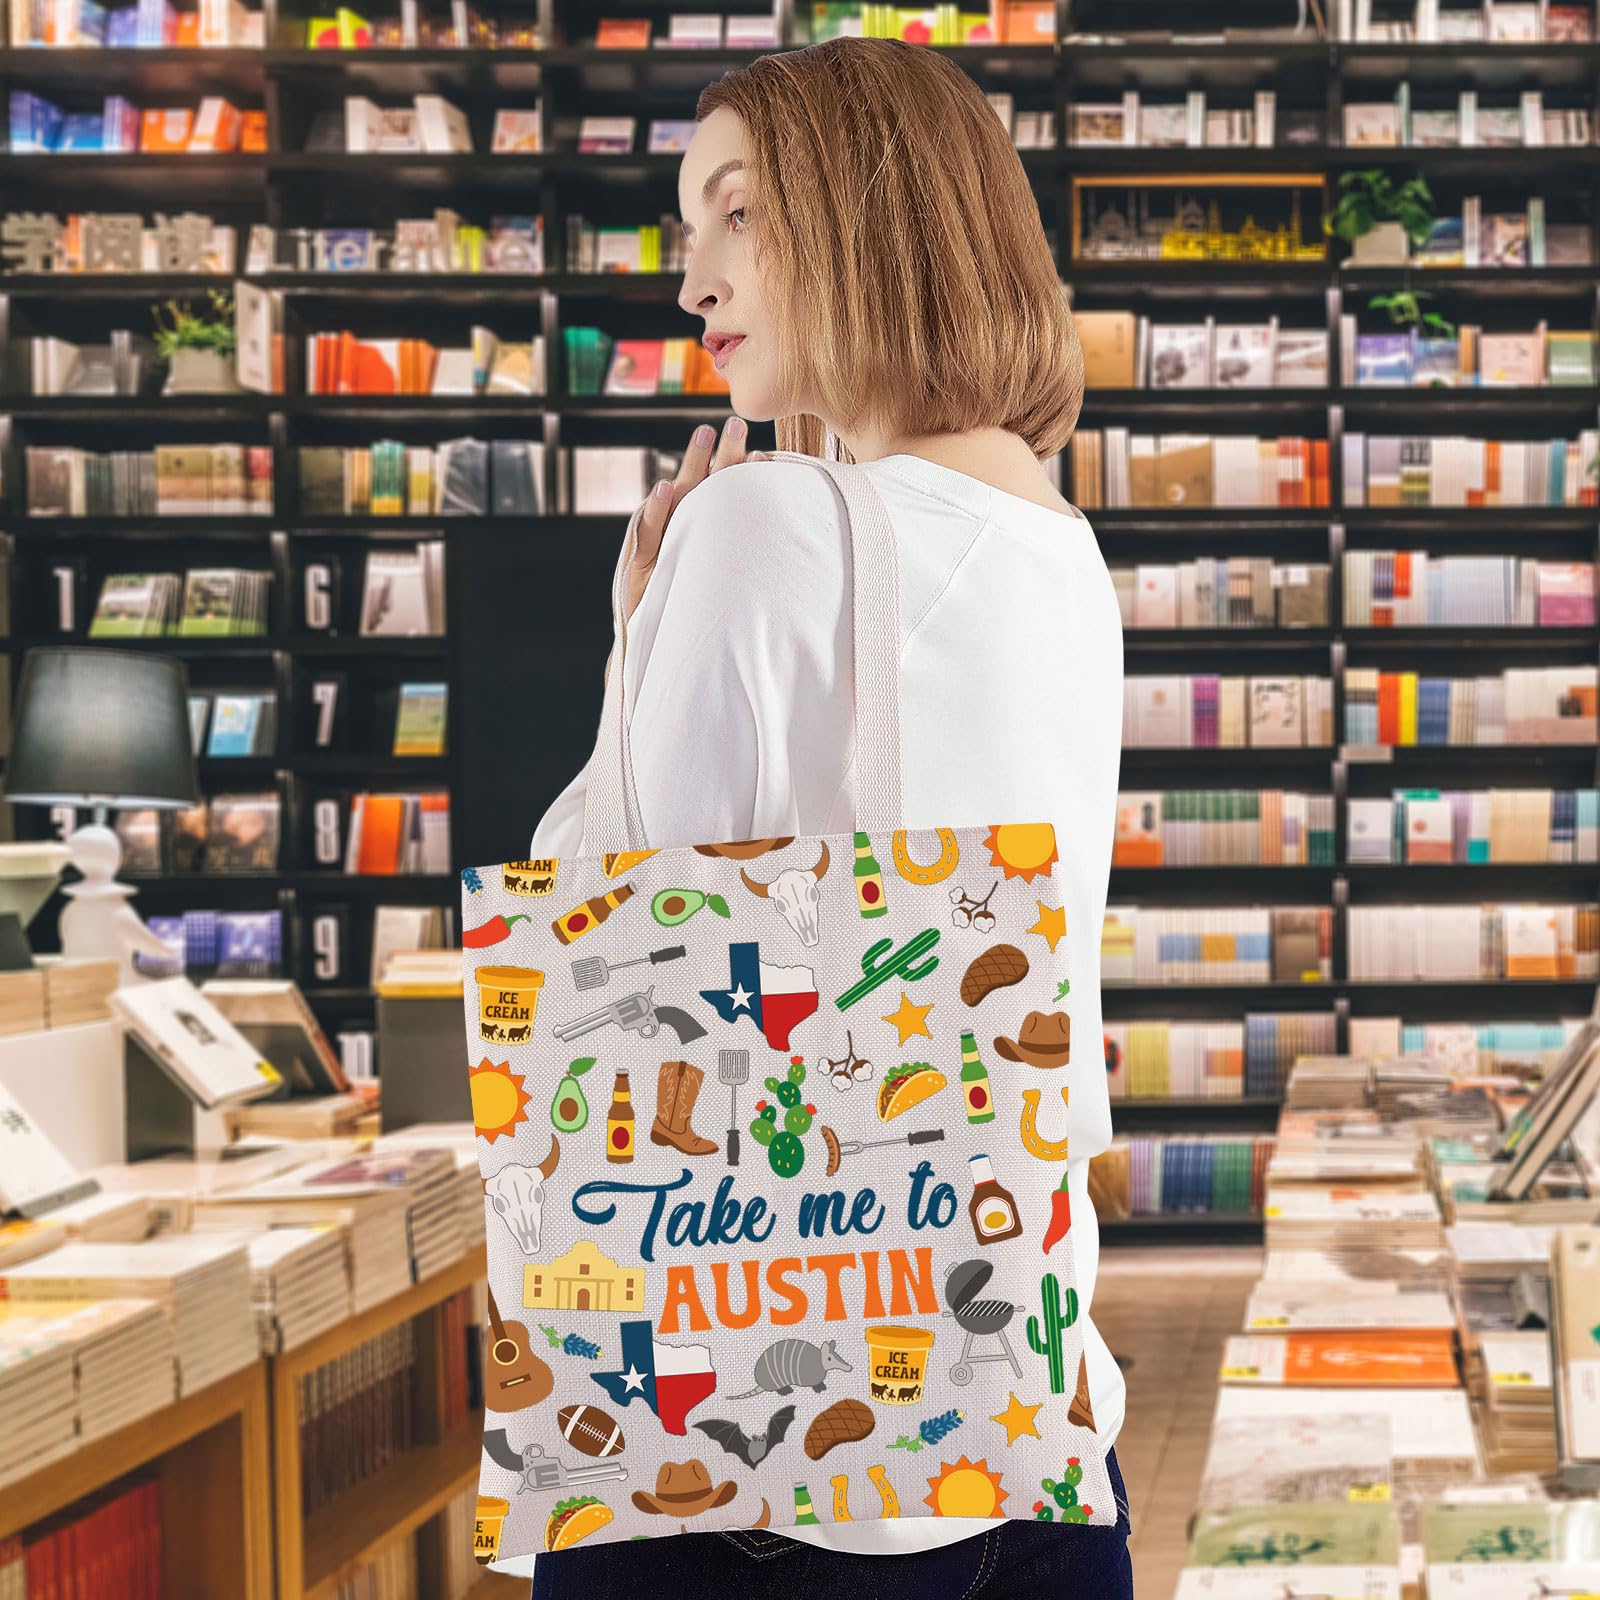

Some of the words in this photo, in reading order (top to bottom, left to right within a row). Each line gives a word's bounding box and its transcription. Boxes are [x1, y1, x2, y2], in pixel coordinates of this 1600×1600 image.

[52, 567, 75, 631] 1
[304, 564, 331, 629] 6
[313, 683, 338, 746] 7
[314, 800, 340, 863] 8
[313, 916, 340, 979] 9
[485, 1006, 530, 1019] CREAM
[498, 992, 518, 1004] ICE
[572, 1168, 776, 1262] Take
[799, 1188, 885, 1238] me
[907, 1161, 958, 1230] to
[657, 1247, 940, 1334] AUSTIN
[875, 1366, 920, 1379] CREAM
[888, 1352, 908, 1364] ICE
